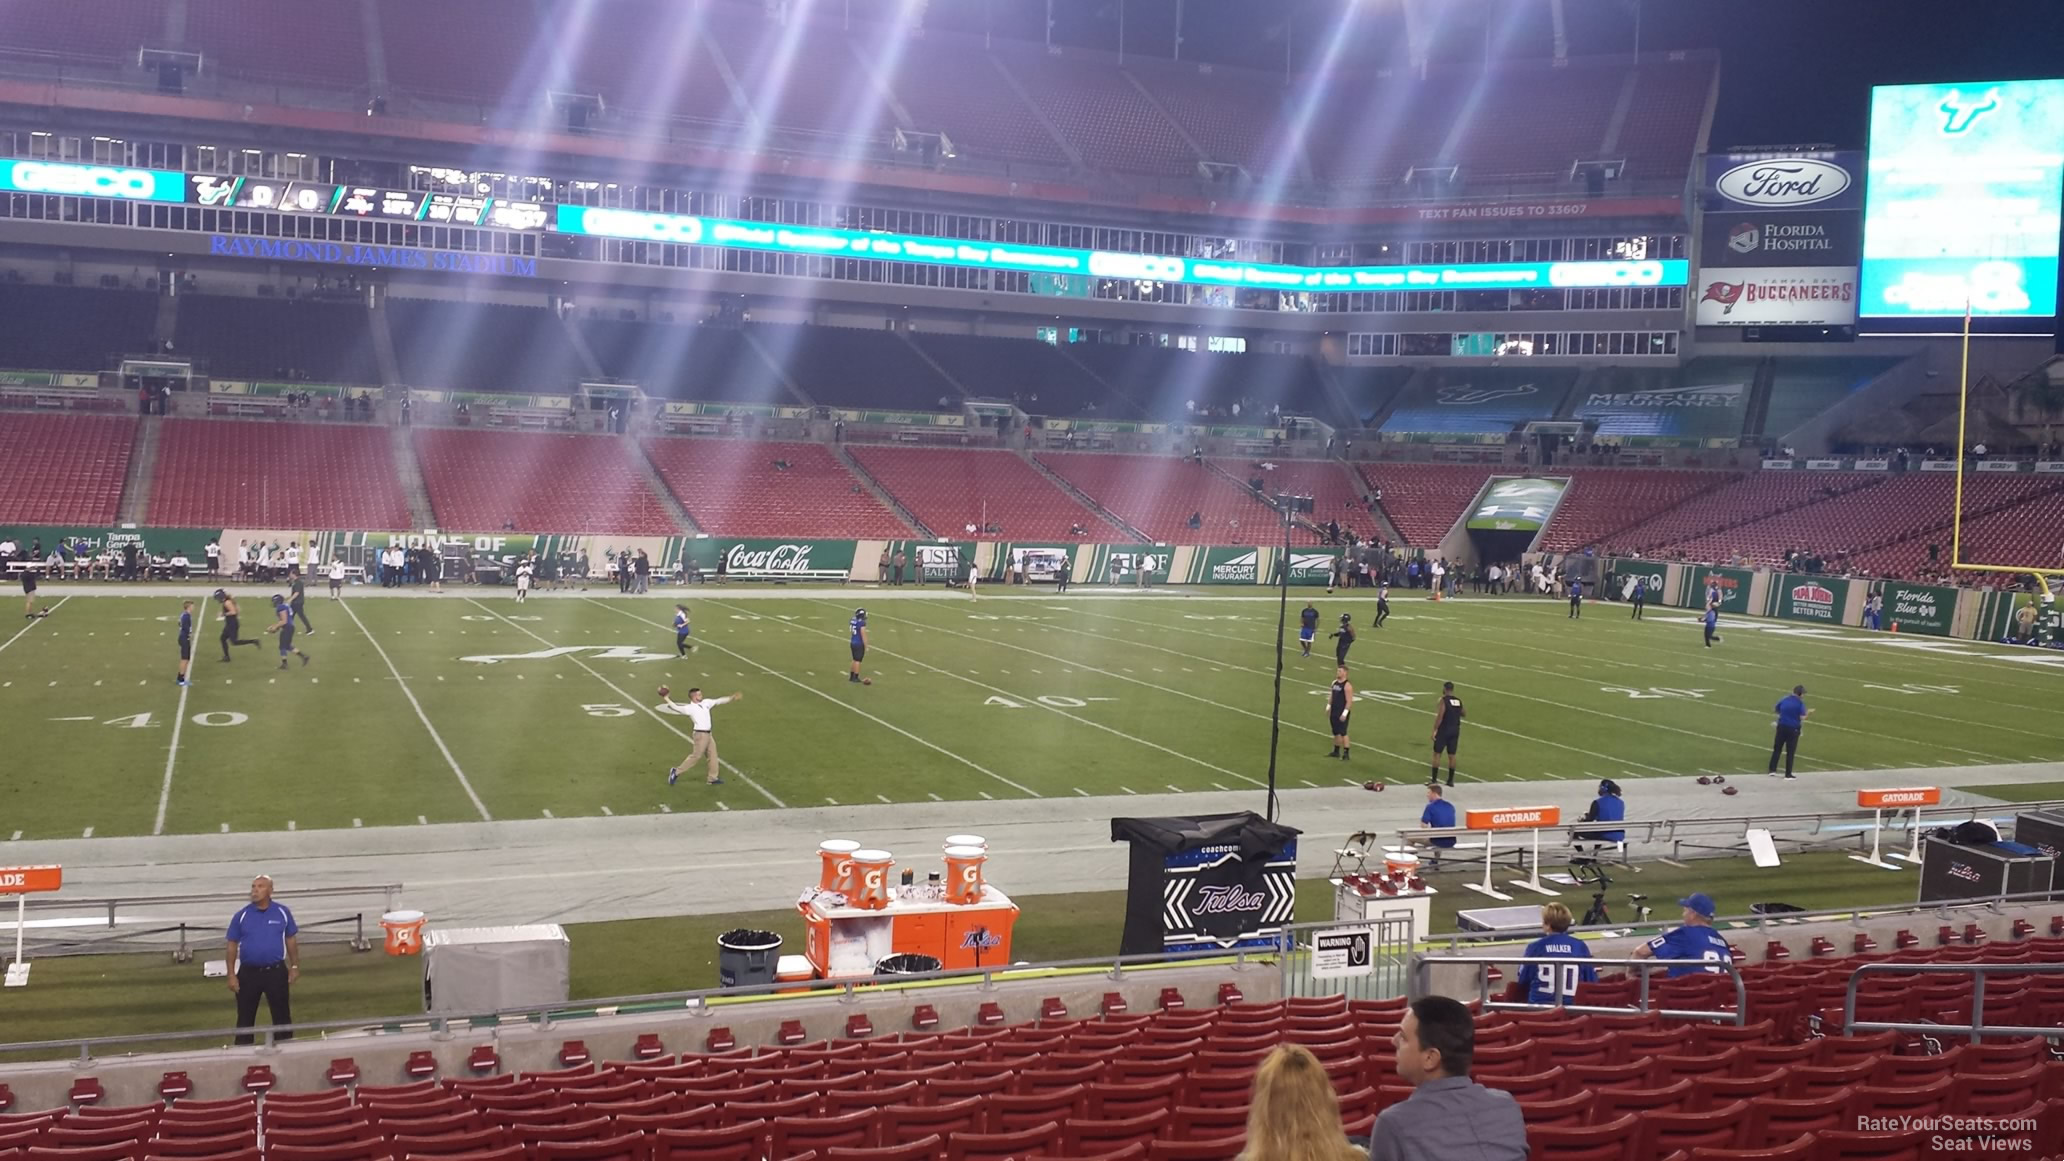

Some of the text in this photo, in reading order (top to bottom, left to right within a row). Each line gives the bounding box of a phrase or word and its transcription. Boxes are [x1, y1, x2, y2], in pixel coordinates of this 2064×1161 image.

[12, 161, 155, 199] GEICO
[1743, 167, 1823, 196] Ford
[252, 185, 272, 206] 0
[299, 189, 318, 210] 0
[1418, 204, 1588, 219] TEXT FAN ISSUES TO 33607
[1764, 224, 1825, 237] FLORIDA
[583, 207, 702, 244] GEICO
[1088, 251, 1185, 281] GEICO
[1549, 260, 1664, 288] GEICO
[1764, 238, 1833, 250] HOSPITAL
[210, 235, 537, 277] RAYMOND JAMES STADIUM
[1747, 282, 1853, 304] BUCCANEERS
[1587, 393, 1741, 401] MERCURY
[106, 532, 141, 542] Tampa
[475, 536, 507, 552] OF
[727, 543, 814, 573] Coca-Cola
[924, 567, 958, 577] EALTH
[1213, 564, 1256, 574] MERCURY
[1289, 568, 1307, 578] ASI
[1212, 572, 1255, 581] INSURANCE
[1793, 586, 1810, 601] PAPA
[1895, 590, 1935, 604] Florida
[1793, 606, 1814, 616] BETTER
[1894, 602, 1917, 614] Blue
[1882, 792, 1924, 803] GATORADE
[1492, 811, 1541, 824] GATORADE
[838, 861, 851, 877] G
[963, 865, 978, 882] G
[865, 870, 881, 889] G
[1192, 884, 1266, 915] Tulsa
[397, 929, 410, 941] G
[1319, 936, 1352, 948] WARNING
[1546, 944, 1572, 954] WALKER
[1537, 963, 1580, 996] 90
